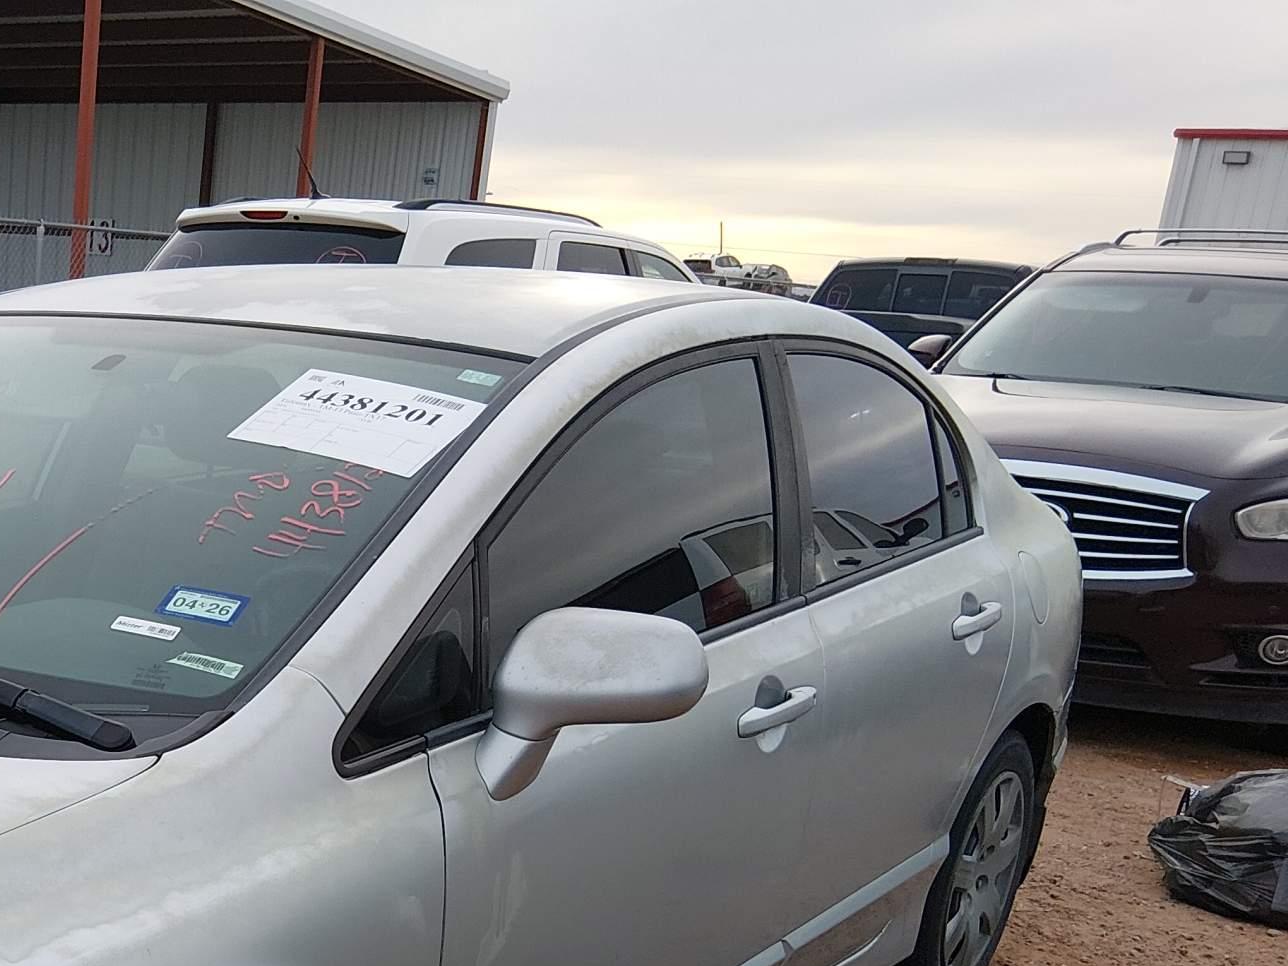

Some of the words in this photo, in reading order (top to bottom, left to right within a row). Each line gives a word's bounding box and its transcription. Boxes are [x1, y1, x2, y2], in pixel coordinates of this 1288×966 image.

[299, 388, 444, 427] 44381201
[172, 596, 198, 610] 04
[205, 602, 232, 617] 26
